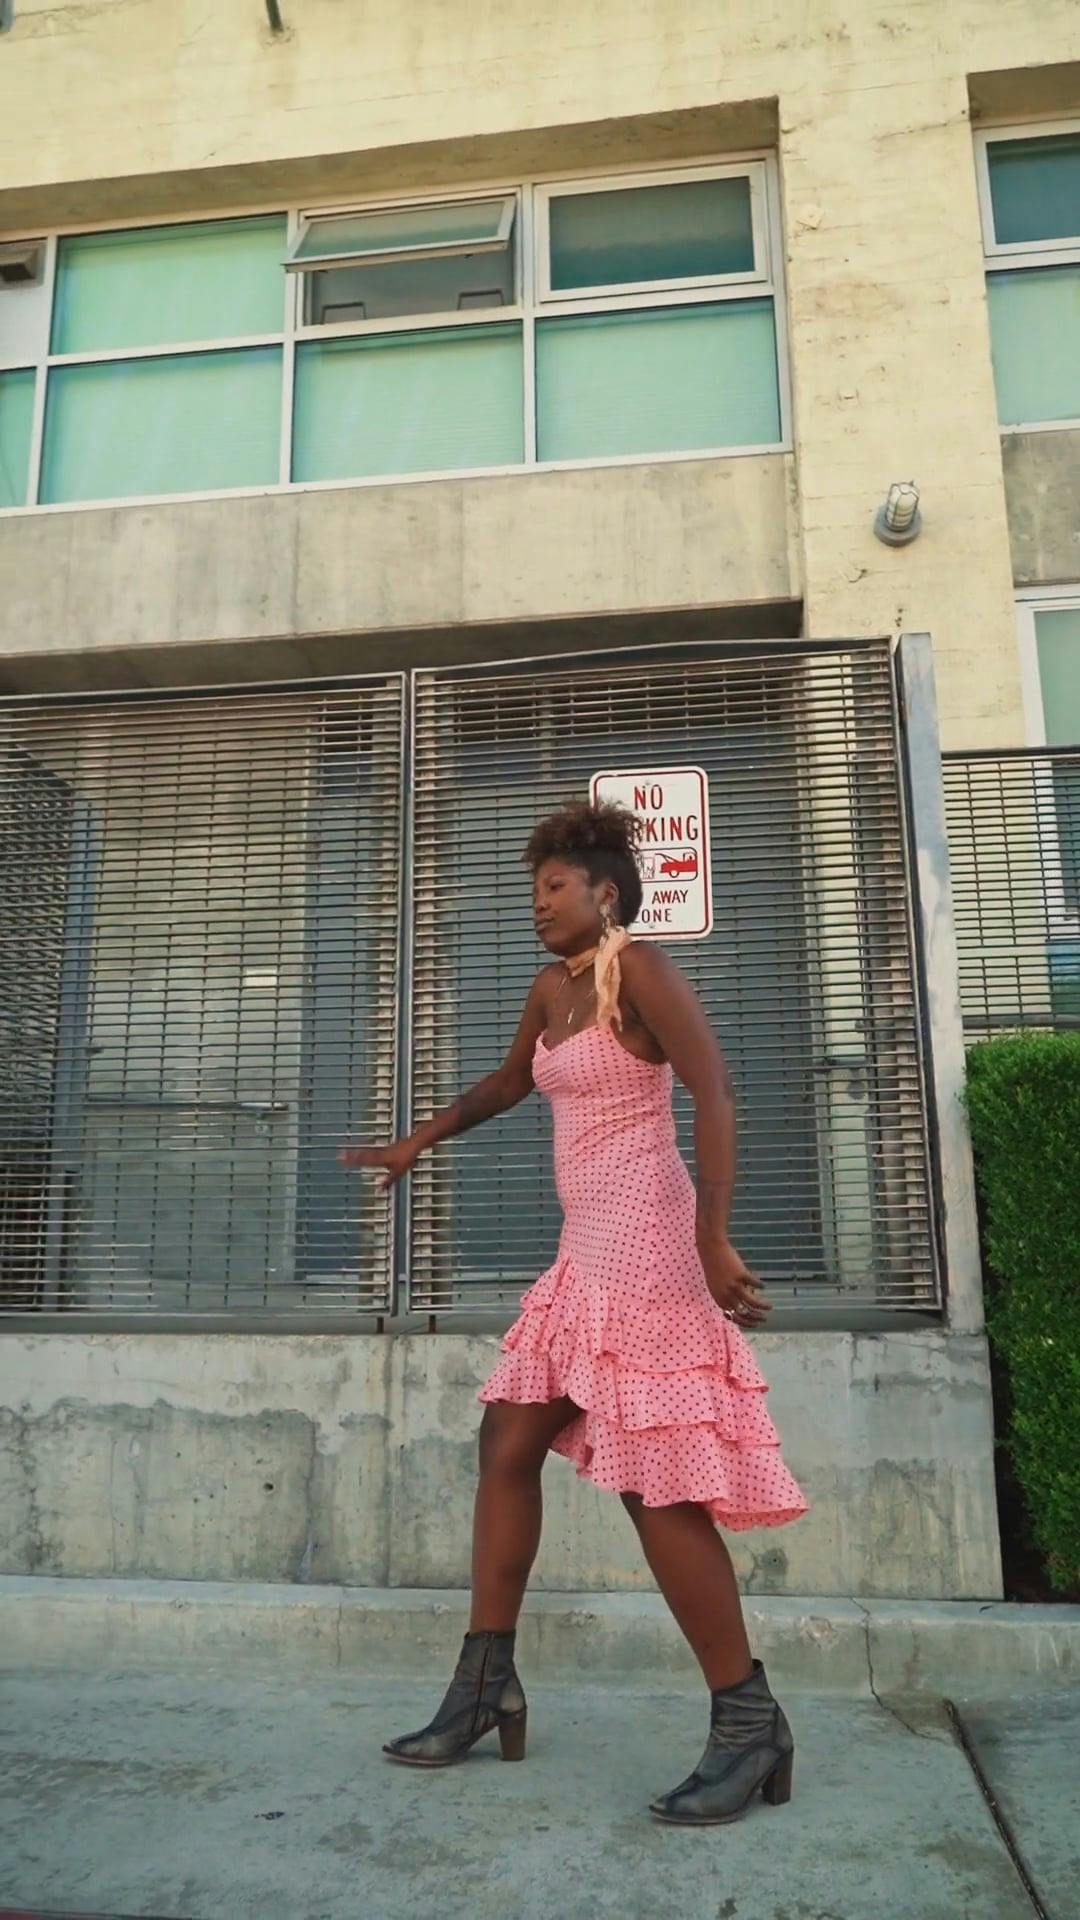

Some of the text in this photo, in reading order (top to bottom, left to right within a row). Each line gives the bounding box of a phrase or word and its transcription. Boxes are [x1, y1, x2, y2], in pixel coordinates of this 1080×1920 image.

[634, 784, 663, 810] NO
[651, 889, 689, 904] AWAY
[632, 908, 672, 923] ONE
